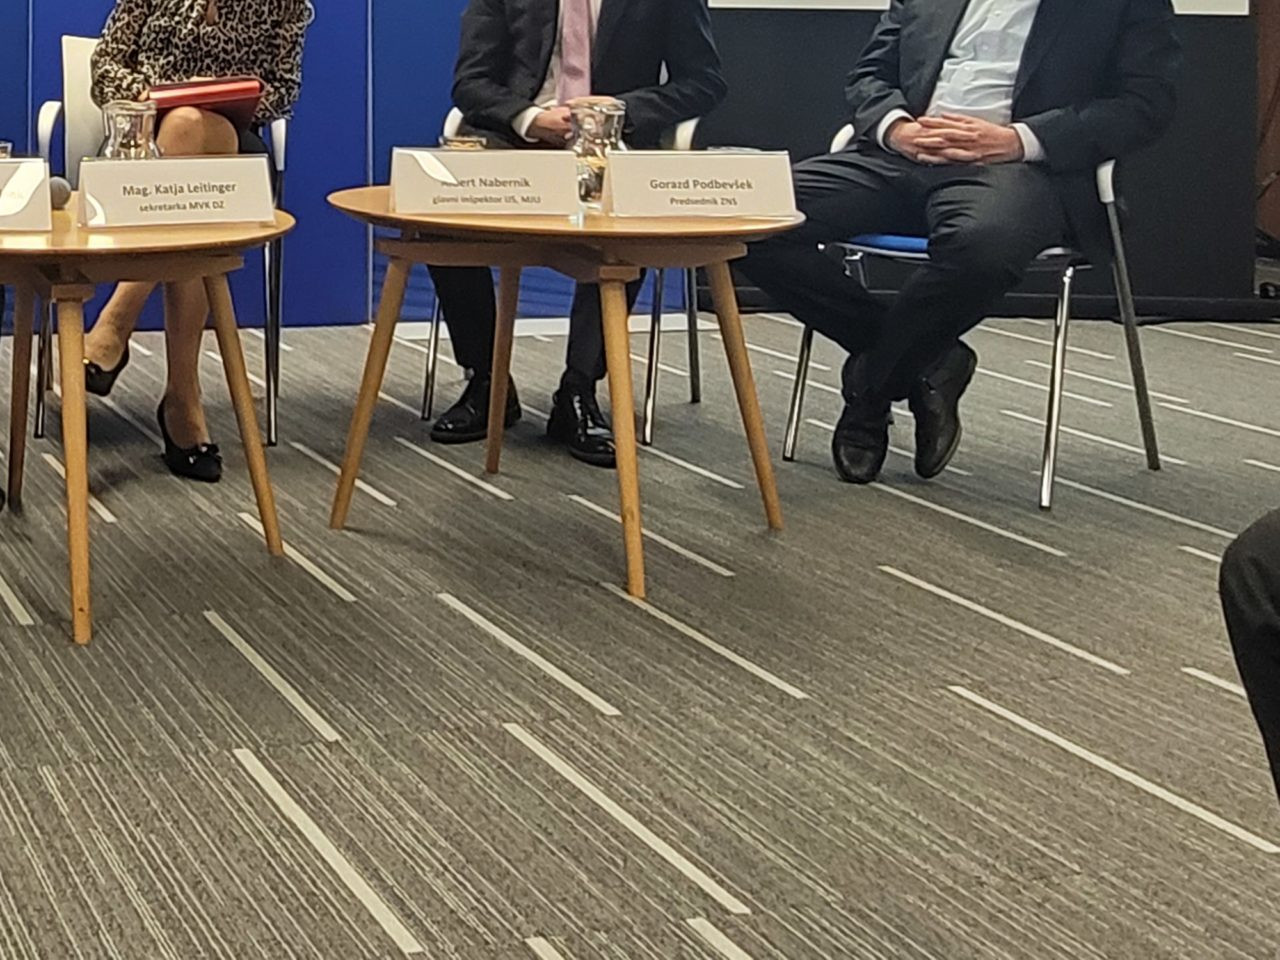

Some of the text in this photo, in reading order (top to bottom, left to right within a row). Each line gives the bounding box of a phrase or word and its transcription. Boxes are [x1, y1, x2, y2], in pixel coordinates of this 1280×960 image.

[479, 178, 531, 188] Nabernik
[650, 179, 753, 190] Gorazd Podbevšek
[122, 182, 236, 198] Mag. Katja Leitinger
[139, 201, 225, 212] sekretarka MVK DZ
[670, 197, 718, 206] Predsednik
